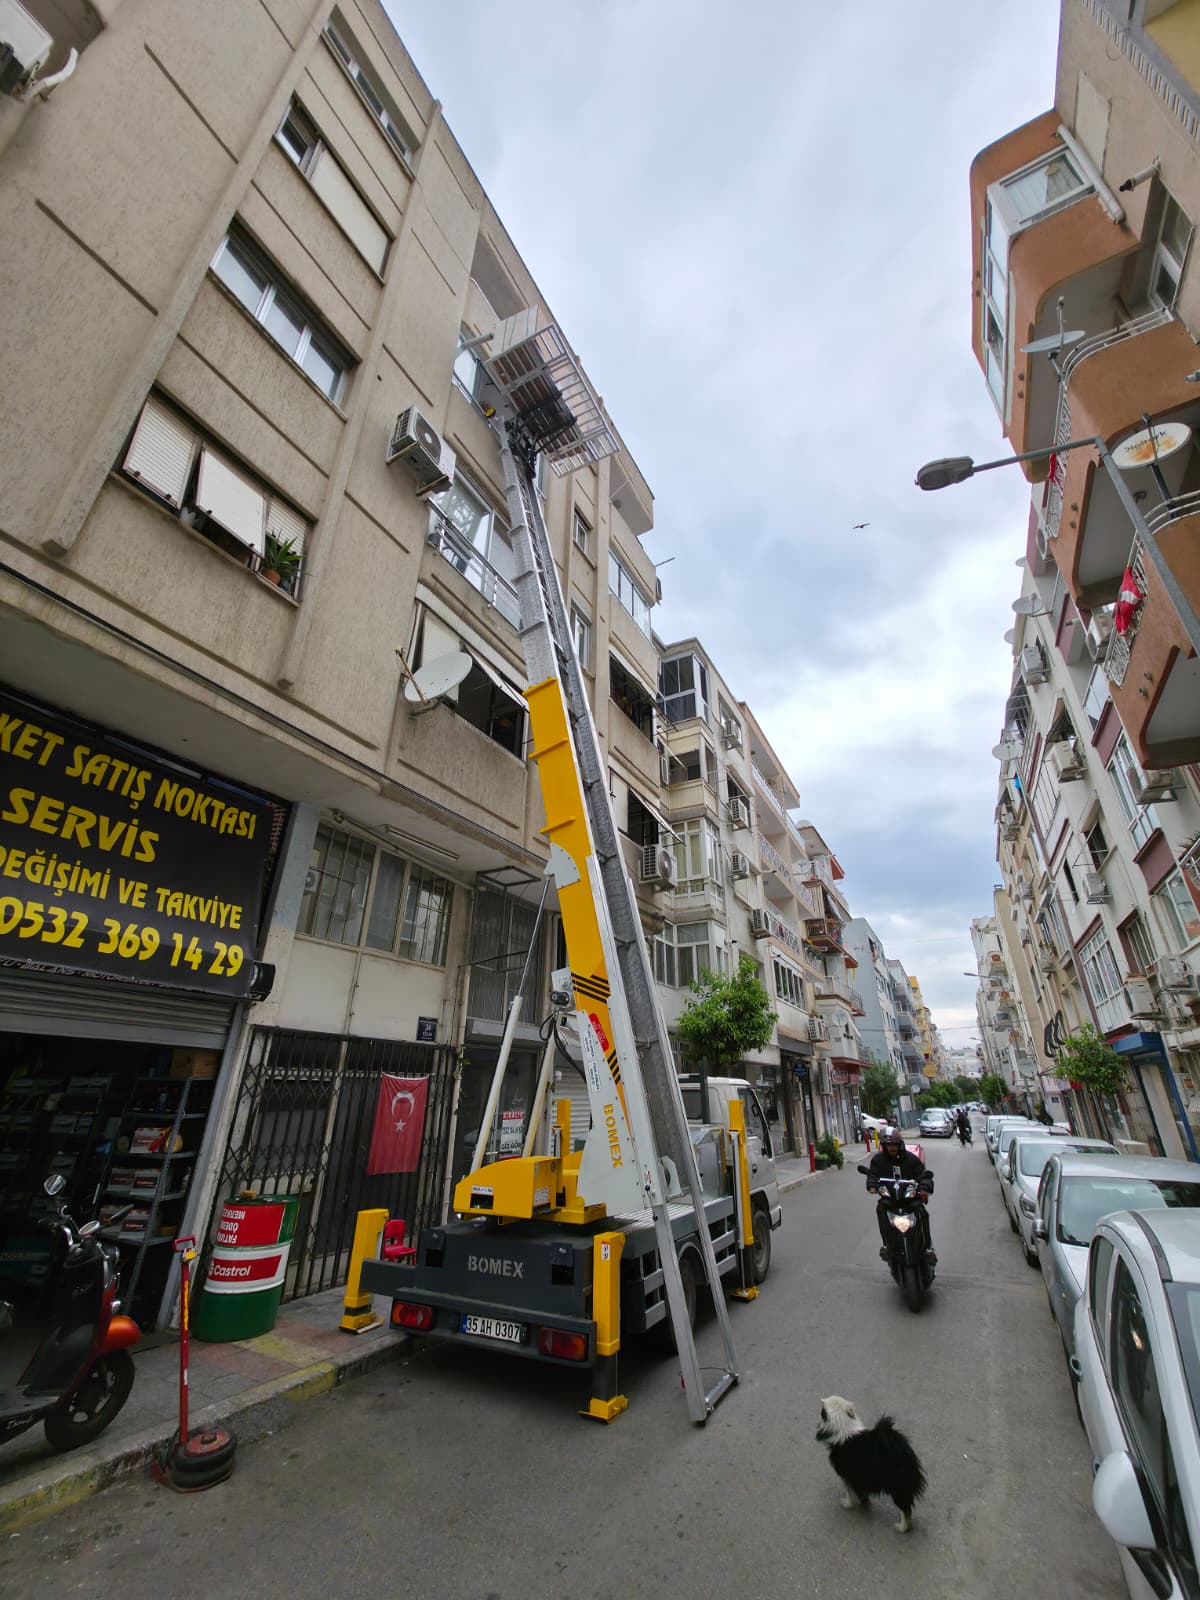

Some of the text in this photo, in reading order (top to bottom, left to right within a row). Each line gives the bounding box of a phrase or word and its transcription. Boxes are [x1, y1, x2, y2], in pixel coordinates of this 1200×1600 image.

[66, 746, 151, 809] SATIŞ
[154, 779, 256, 839] NOKTASI
[2, 788, 159, 863] SERVİS
[119, 877, 149, 909] VE
[155, 887, 243, 930] TAKVİYE
[0, 895, 244, 977] 0532 369 14 29
[602, 1103, 625, 1169] BOMEX
[214, 1264, 252, 1276] Castrol
[467, 1255, 524, 1279] BOMEX
[466, 1317, 520, 1341] 35 AH 0307
